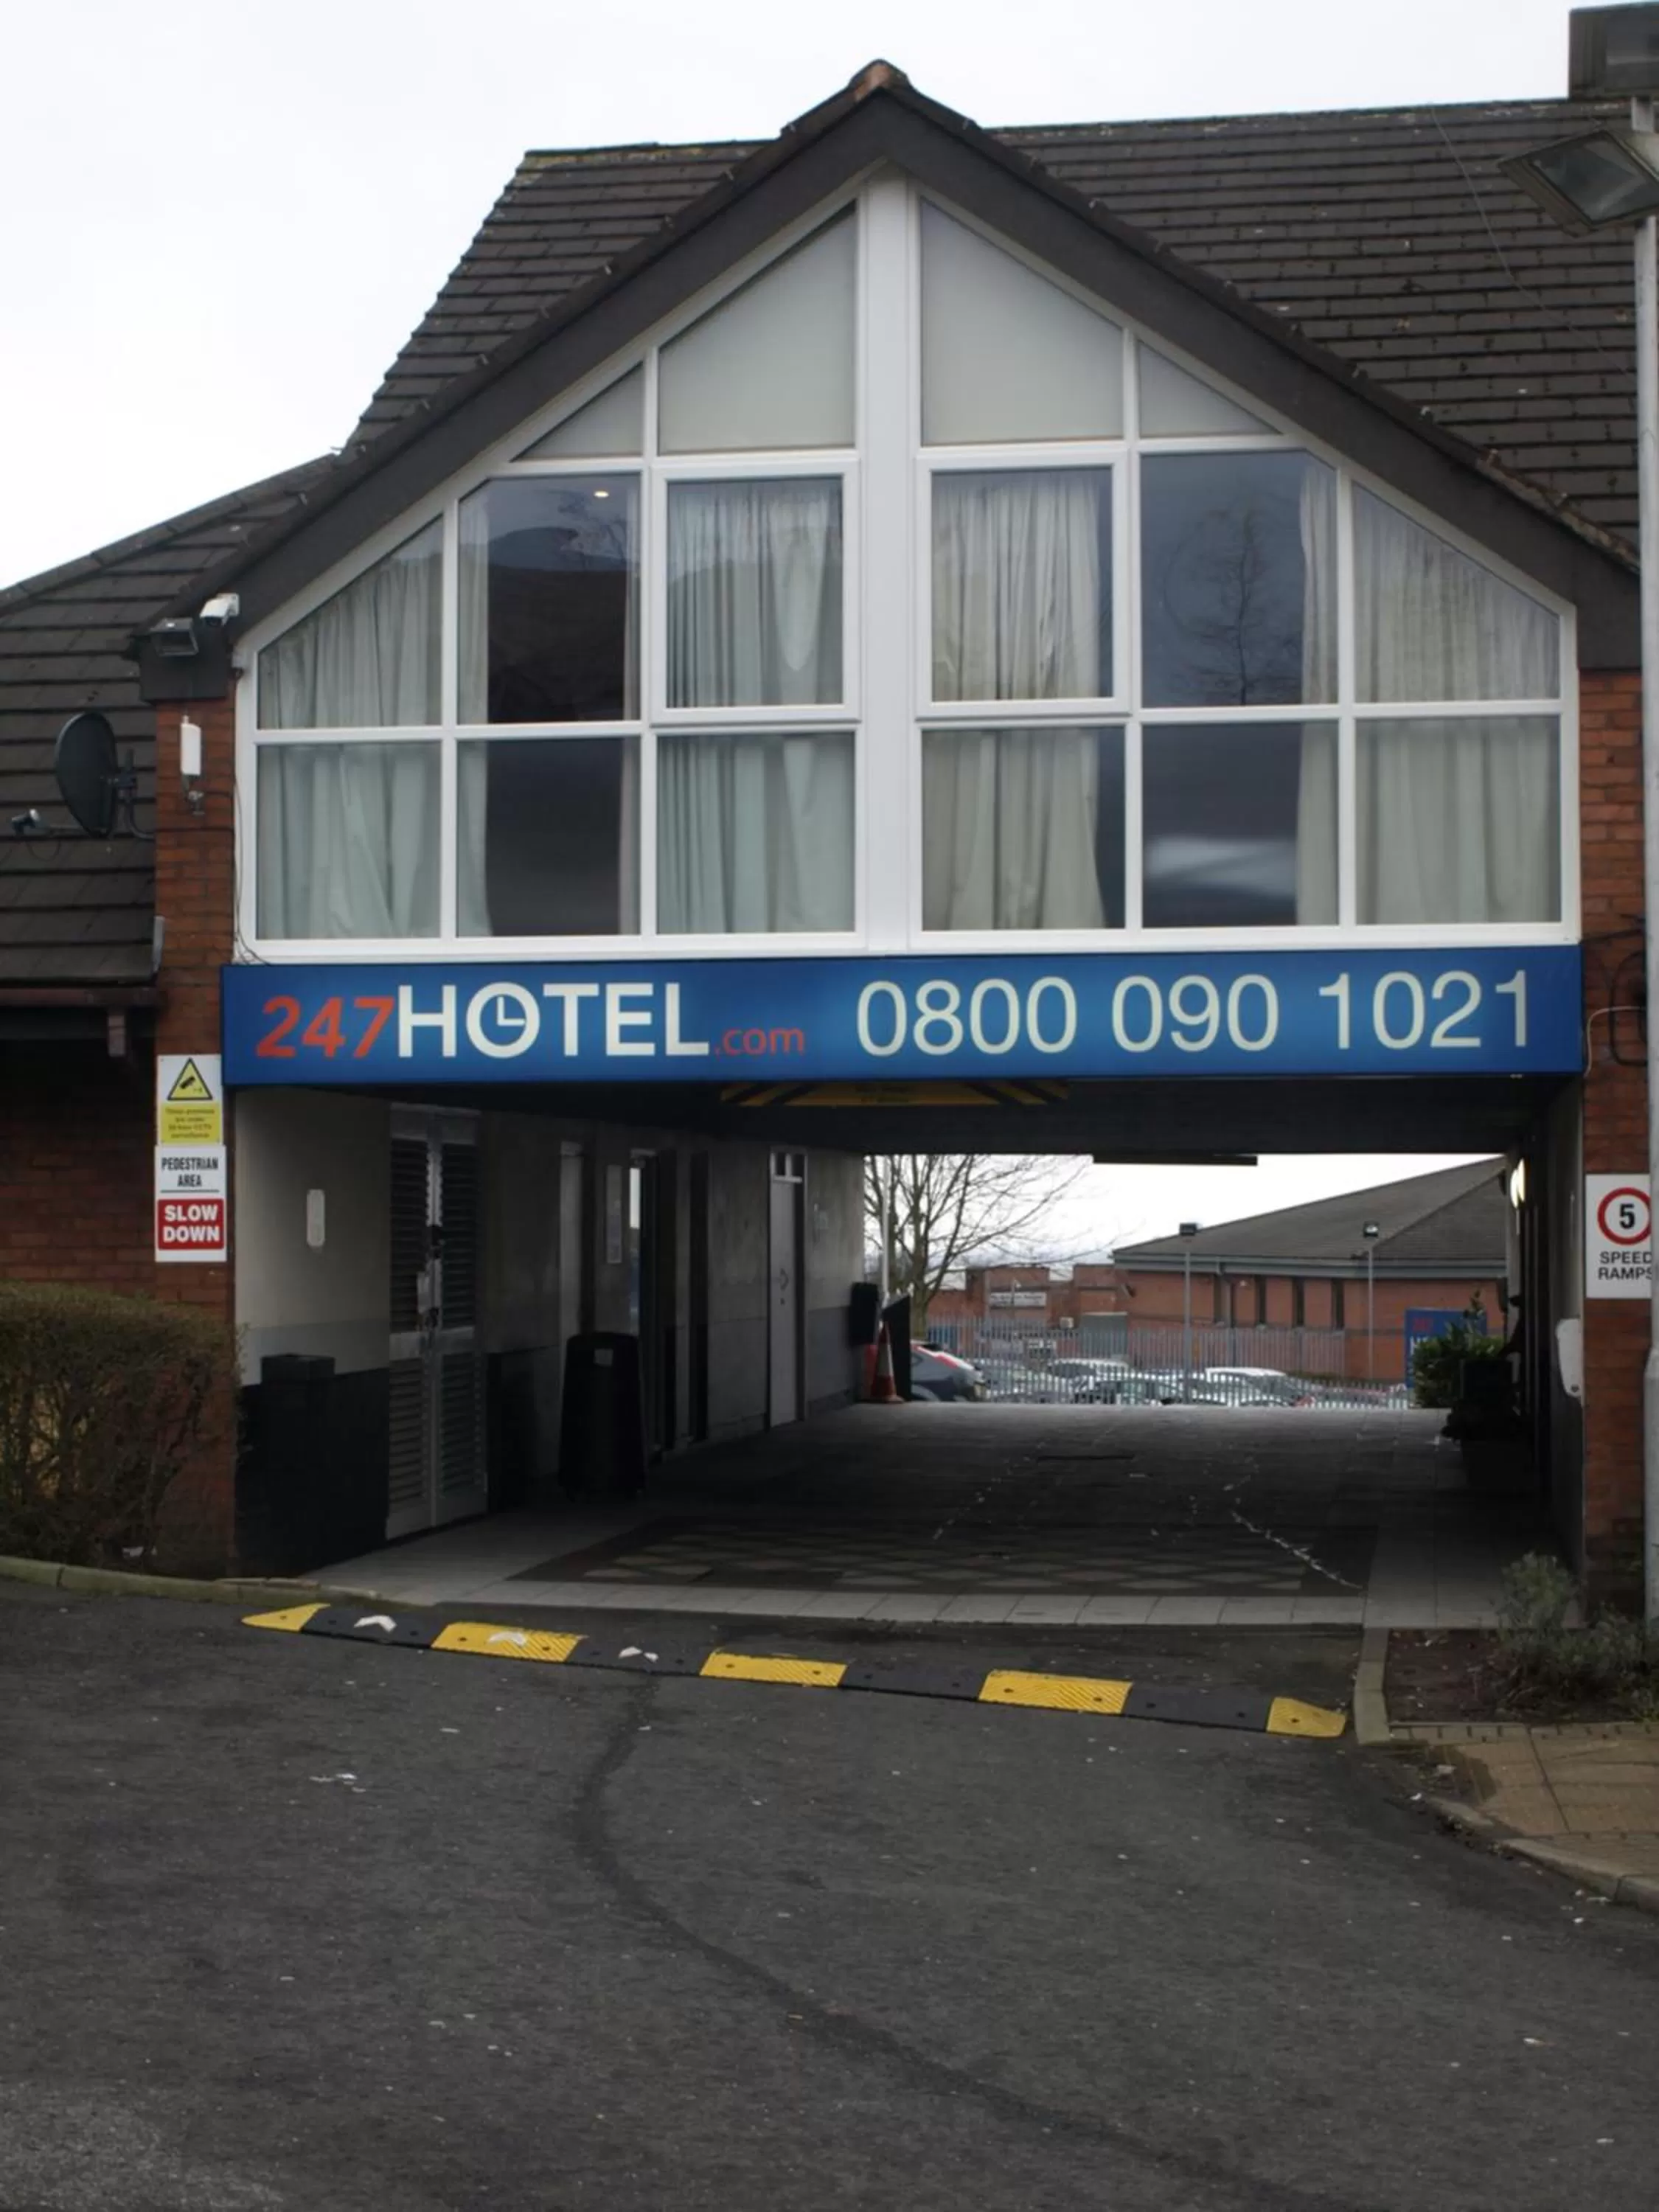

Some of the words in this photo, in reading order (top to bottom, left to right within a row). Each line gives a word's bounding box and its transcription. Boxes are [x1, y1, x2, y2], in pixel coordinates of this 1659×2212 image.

[857, 976, 1077, 1057] 0800
[1112, 973, 1279, 1053] 090
[1318, 969, 1528, 1050] 1021
[161, 1157, 219, 1171] PEDESTRIAN
[177, 1174, 202, 1187] AREA
[164, 1204, 218, 1222] SLOW
[1619, 1203, 1635, 1230] 5
[163, 1225, 220, 1242] DOWN
